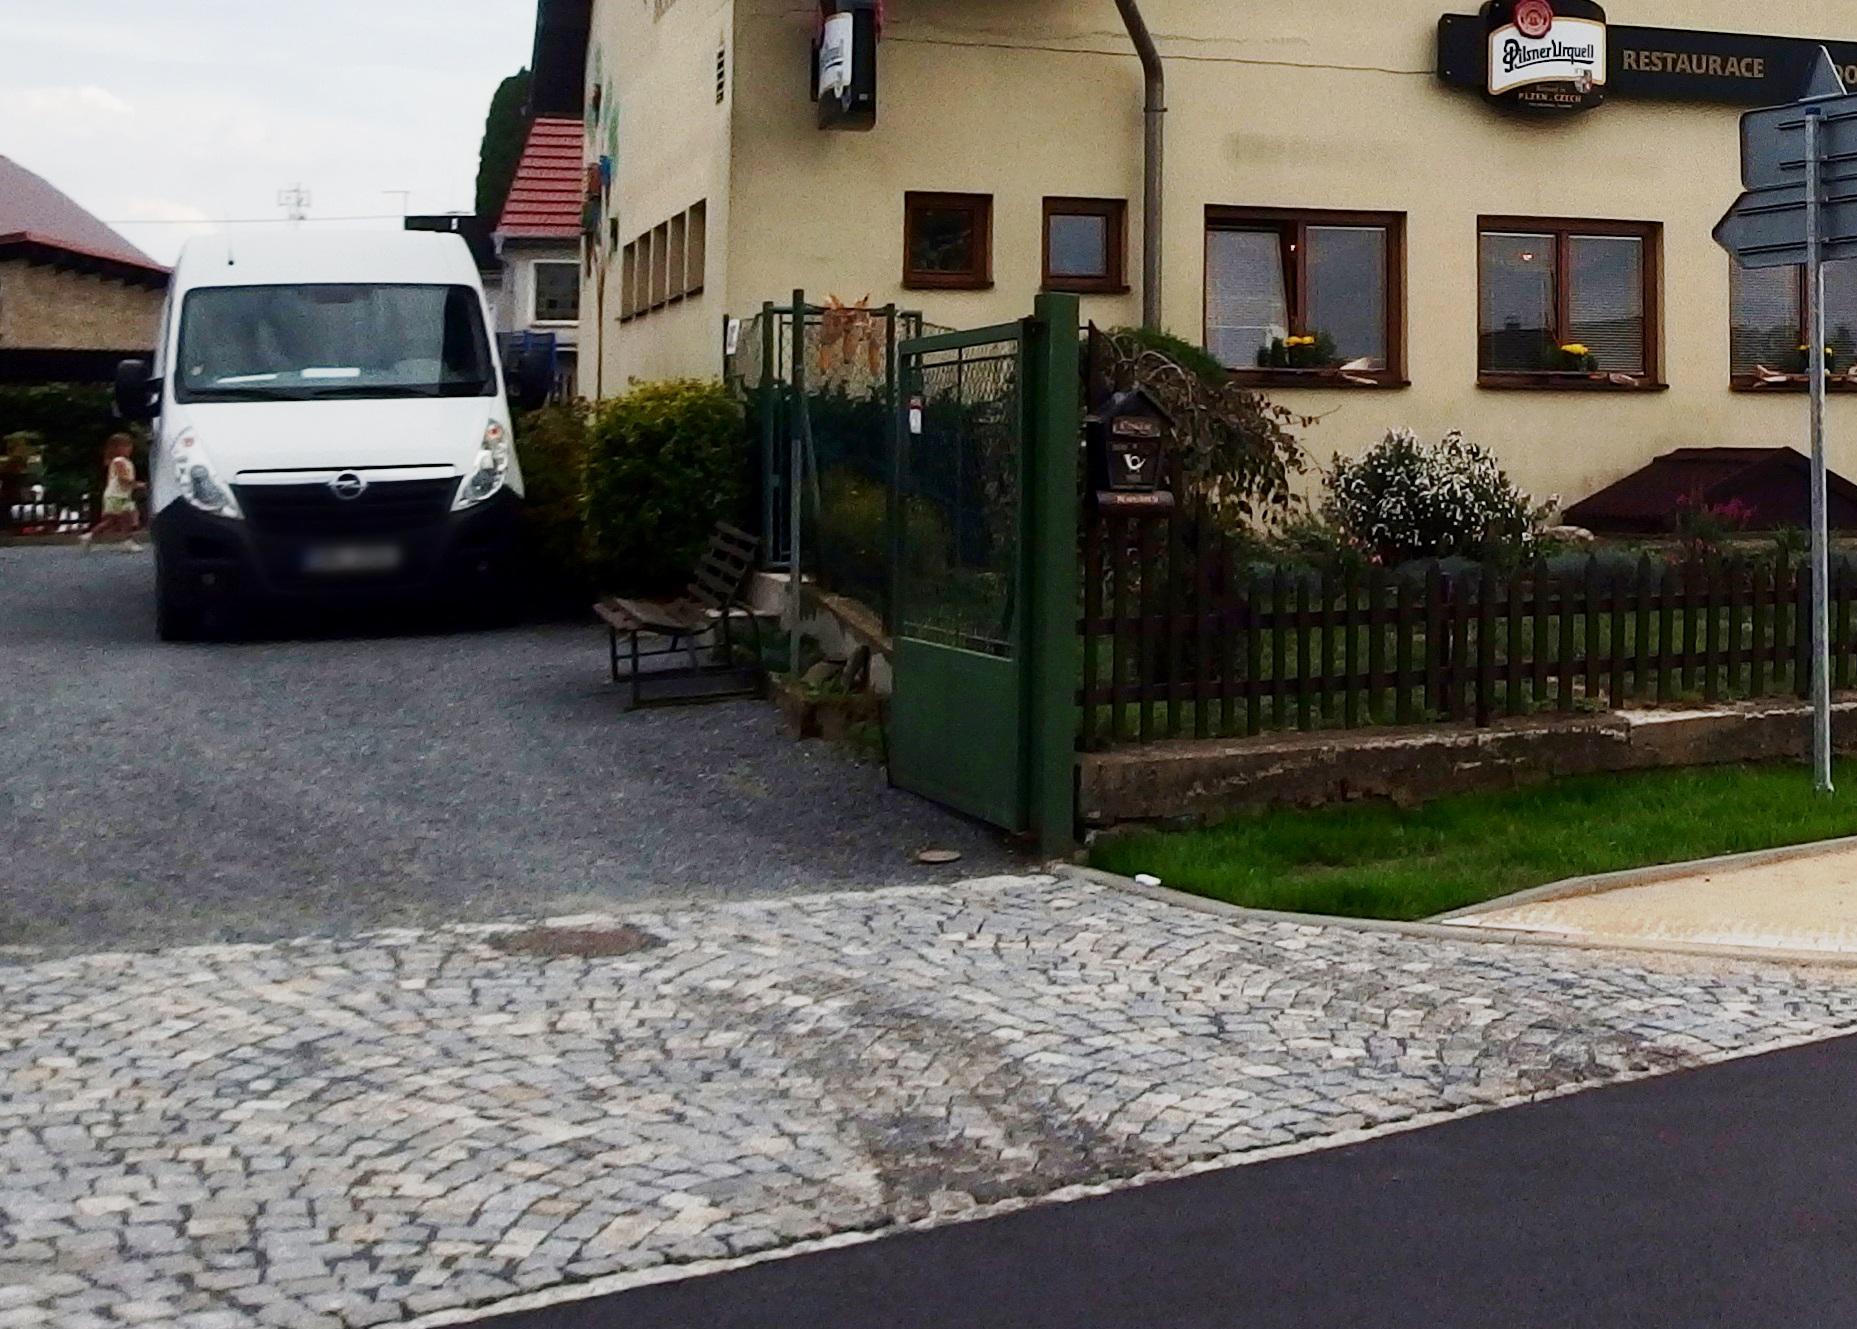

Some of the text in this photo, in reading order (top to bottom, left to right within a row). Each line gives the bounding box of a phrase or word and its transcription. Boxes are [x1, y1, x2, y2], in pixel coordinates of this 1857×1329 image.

[1502, 38, 1594, 73] Pilsner Urquell
[1622, 49, 1765, 78] RESTAURACE
